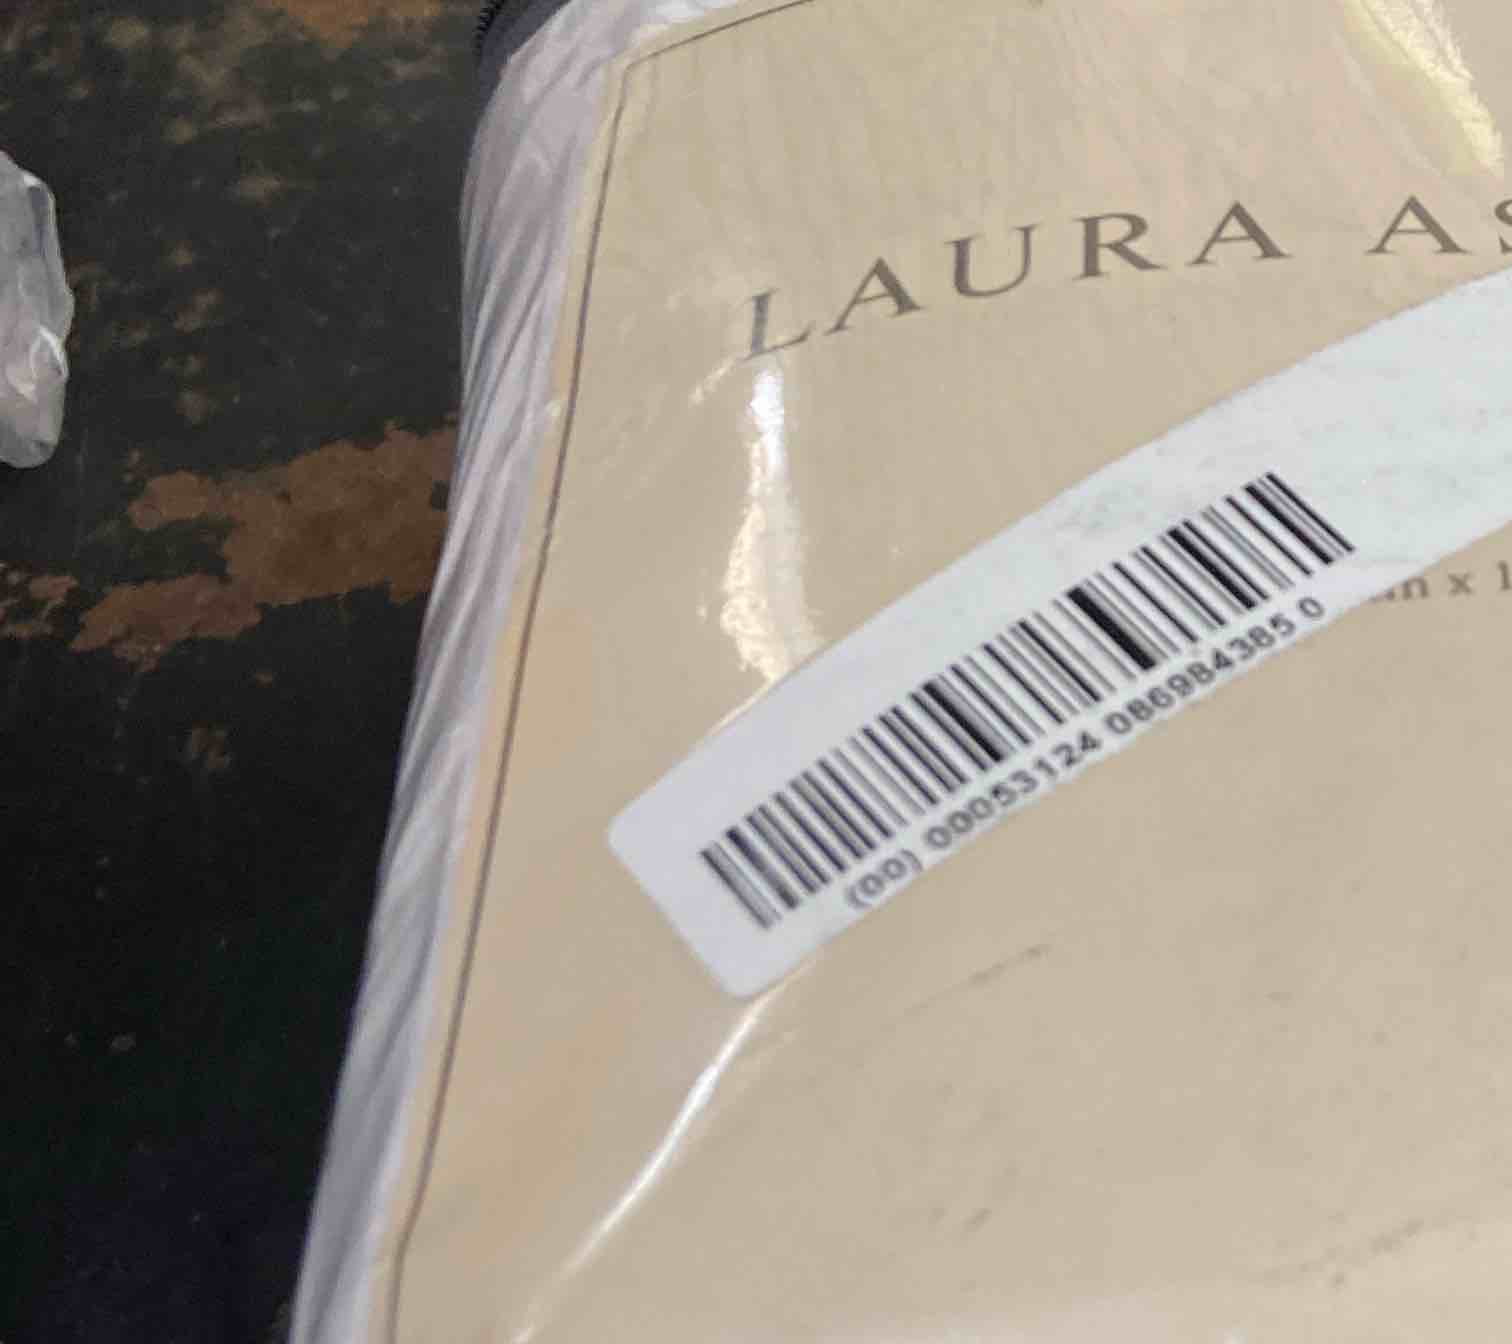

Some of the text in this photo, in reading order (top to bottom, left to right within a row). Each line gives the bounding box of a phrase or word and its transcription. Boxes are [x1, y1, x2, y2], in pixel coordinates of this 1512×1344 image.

[745, 199, 1293, 359] LAURA
[1449, 569, 1476, 596] x
[843, 595, 1327, 909] (00) 00053124 086984385 0
